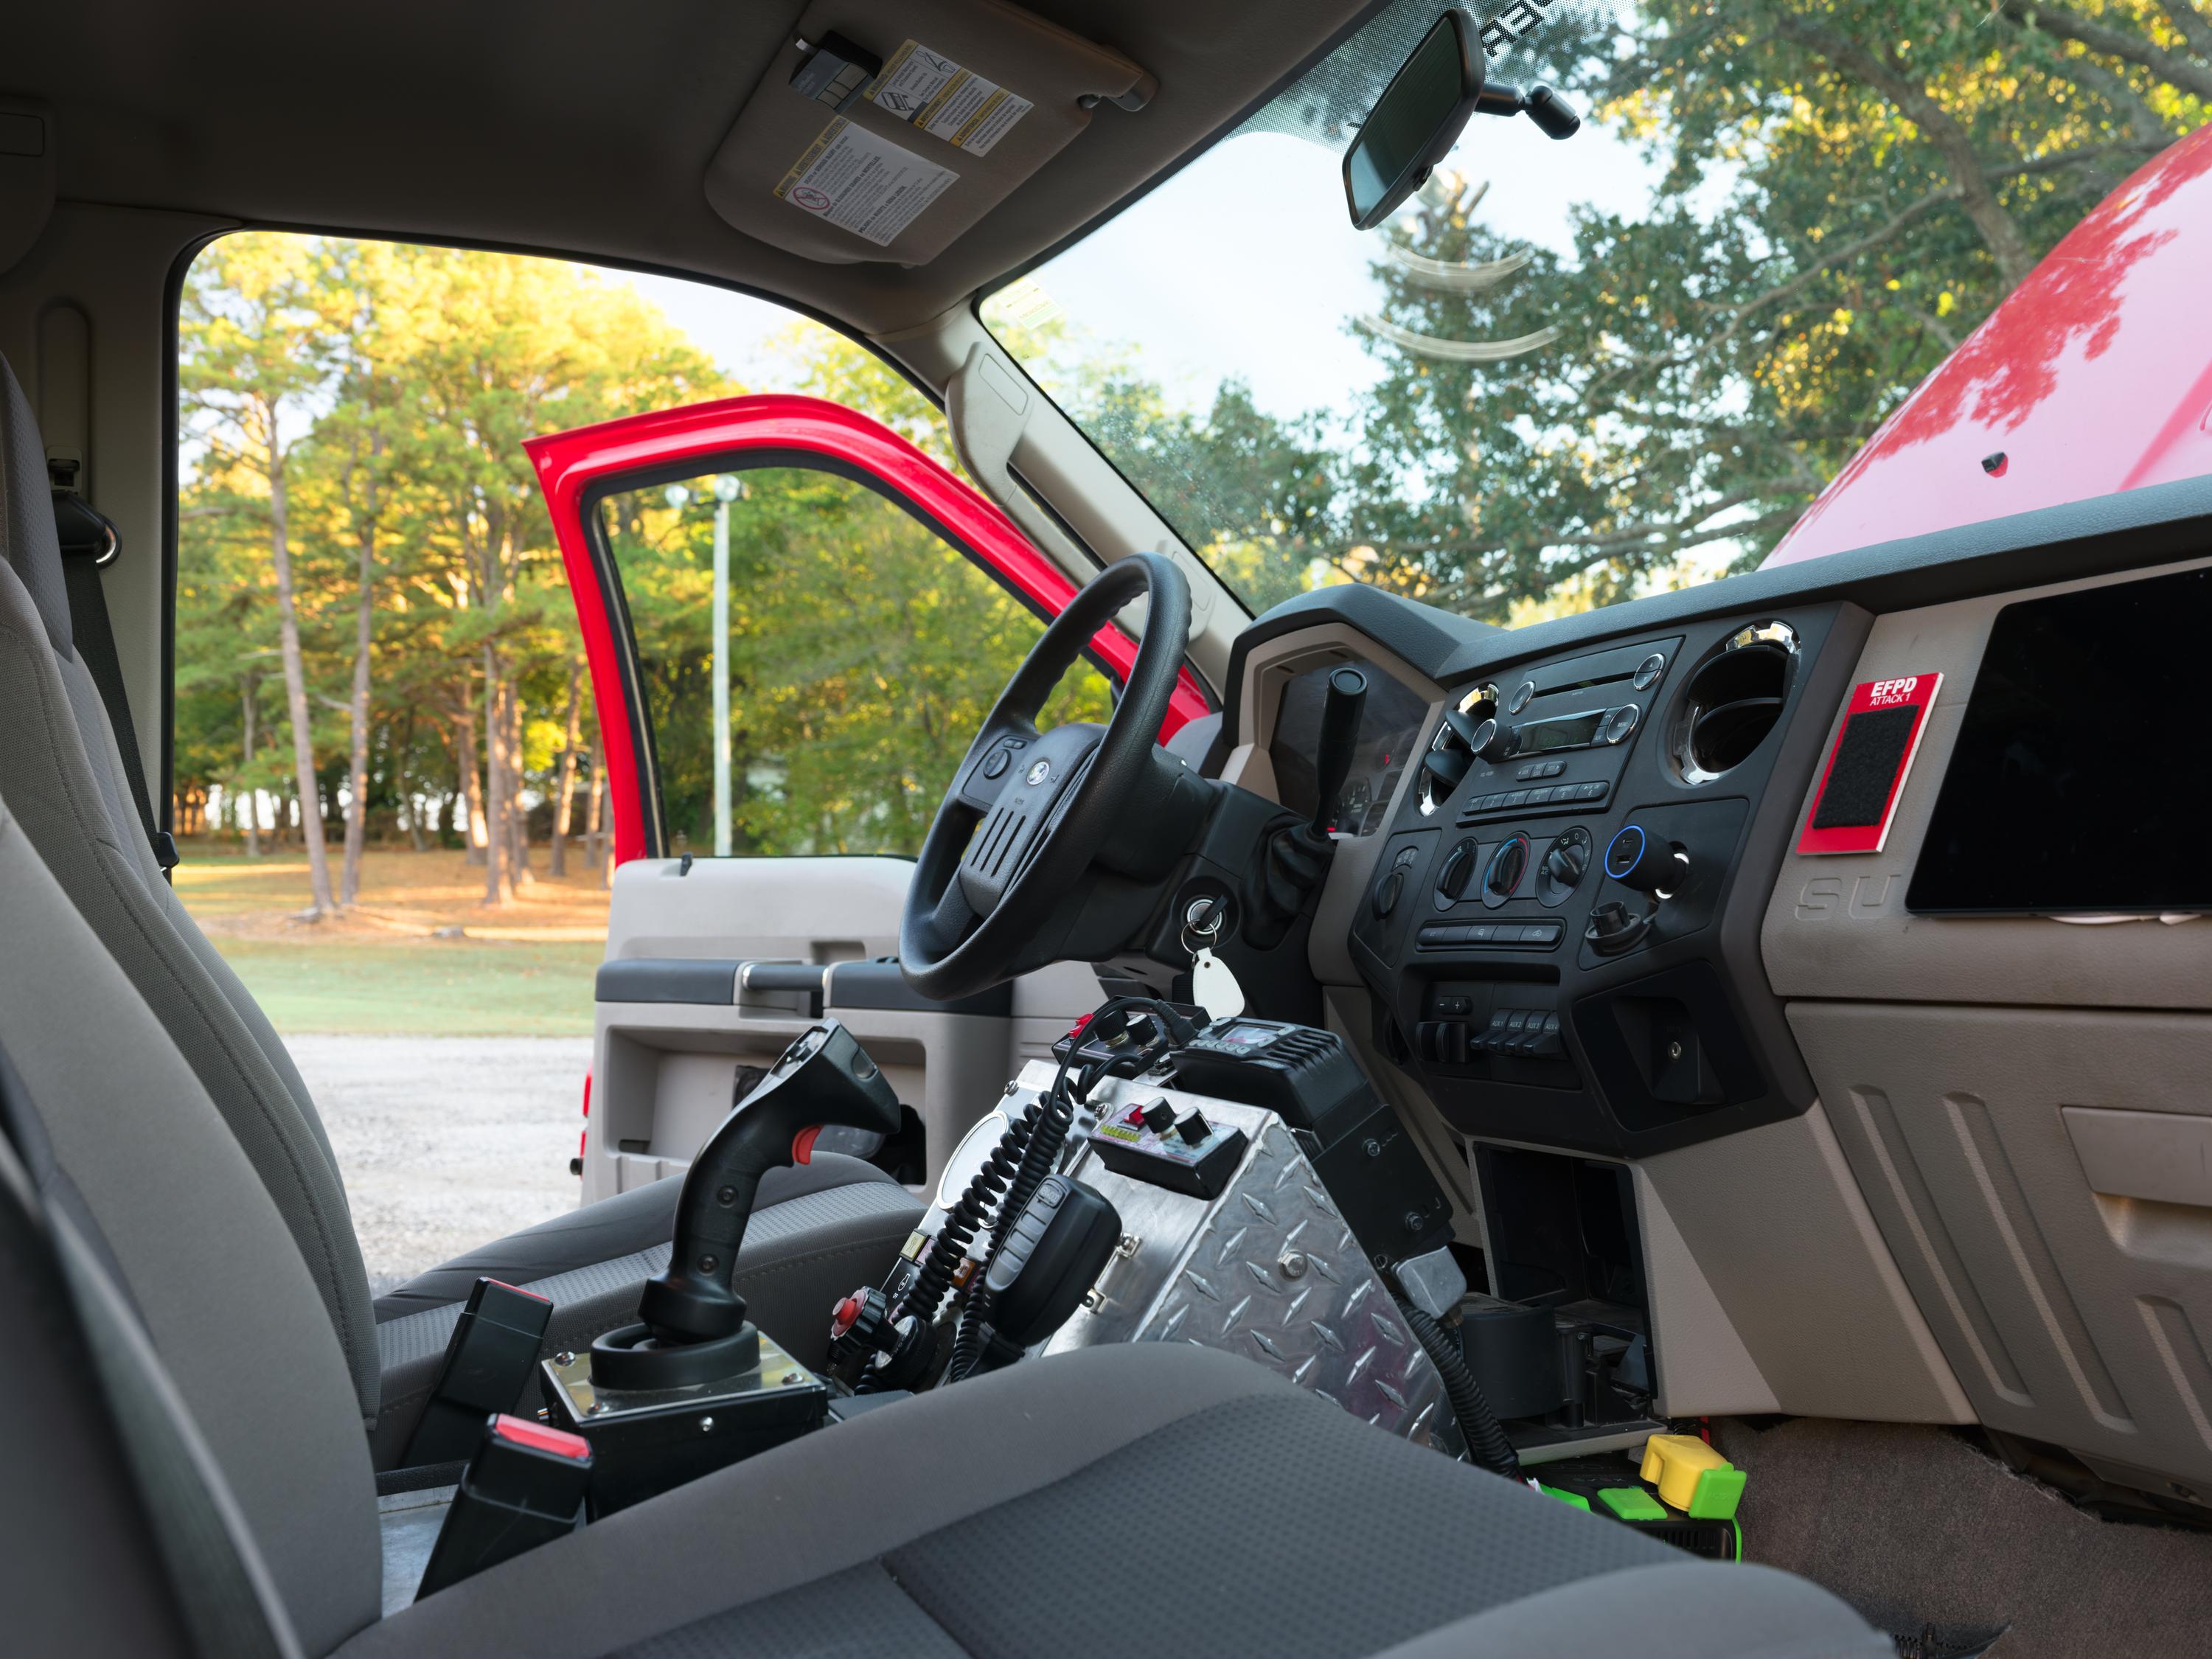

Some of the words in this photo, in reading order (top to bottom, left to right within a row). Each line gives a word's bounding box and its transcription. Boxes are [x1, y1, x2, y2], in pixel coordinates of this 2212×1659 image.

[1871, 677, 1917, 697] EFPD
[1869, 694, 1905, 706] ATTACK
[1905, 692, 1911, 702] 1
